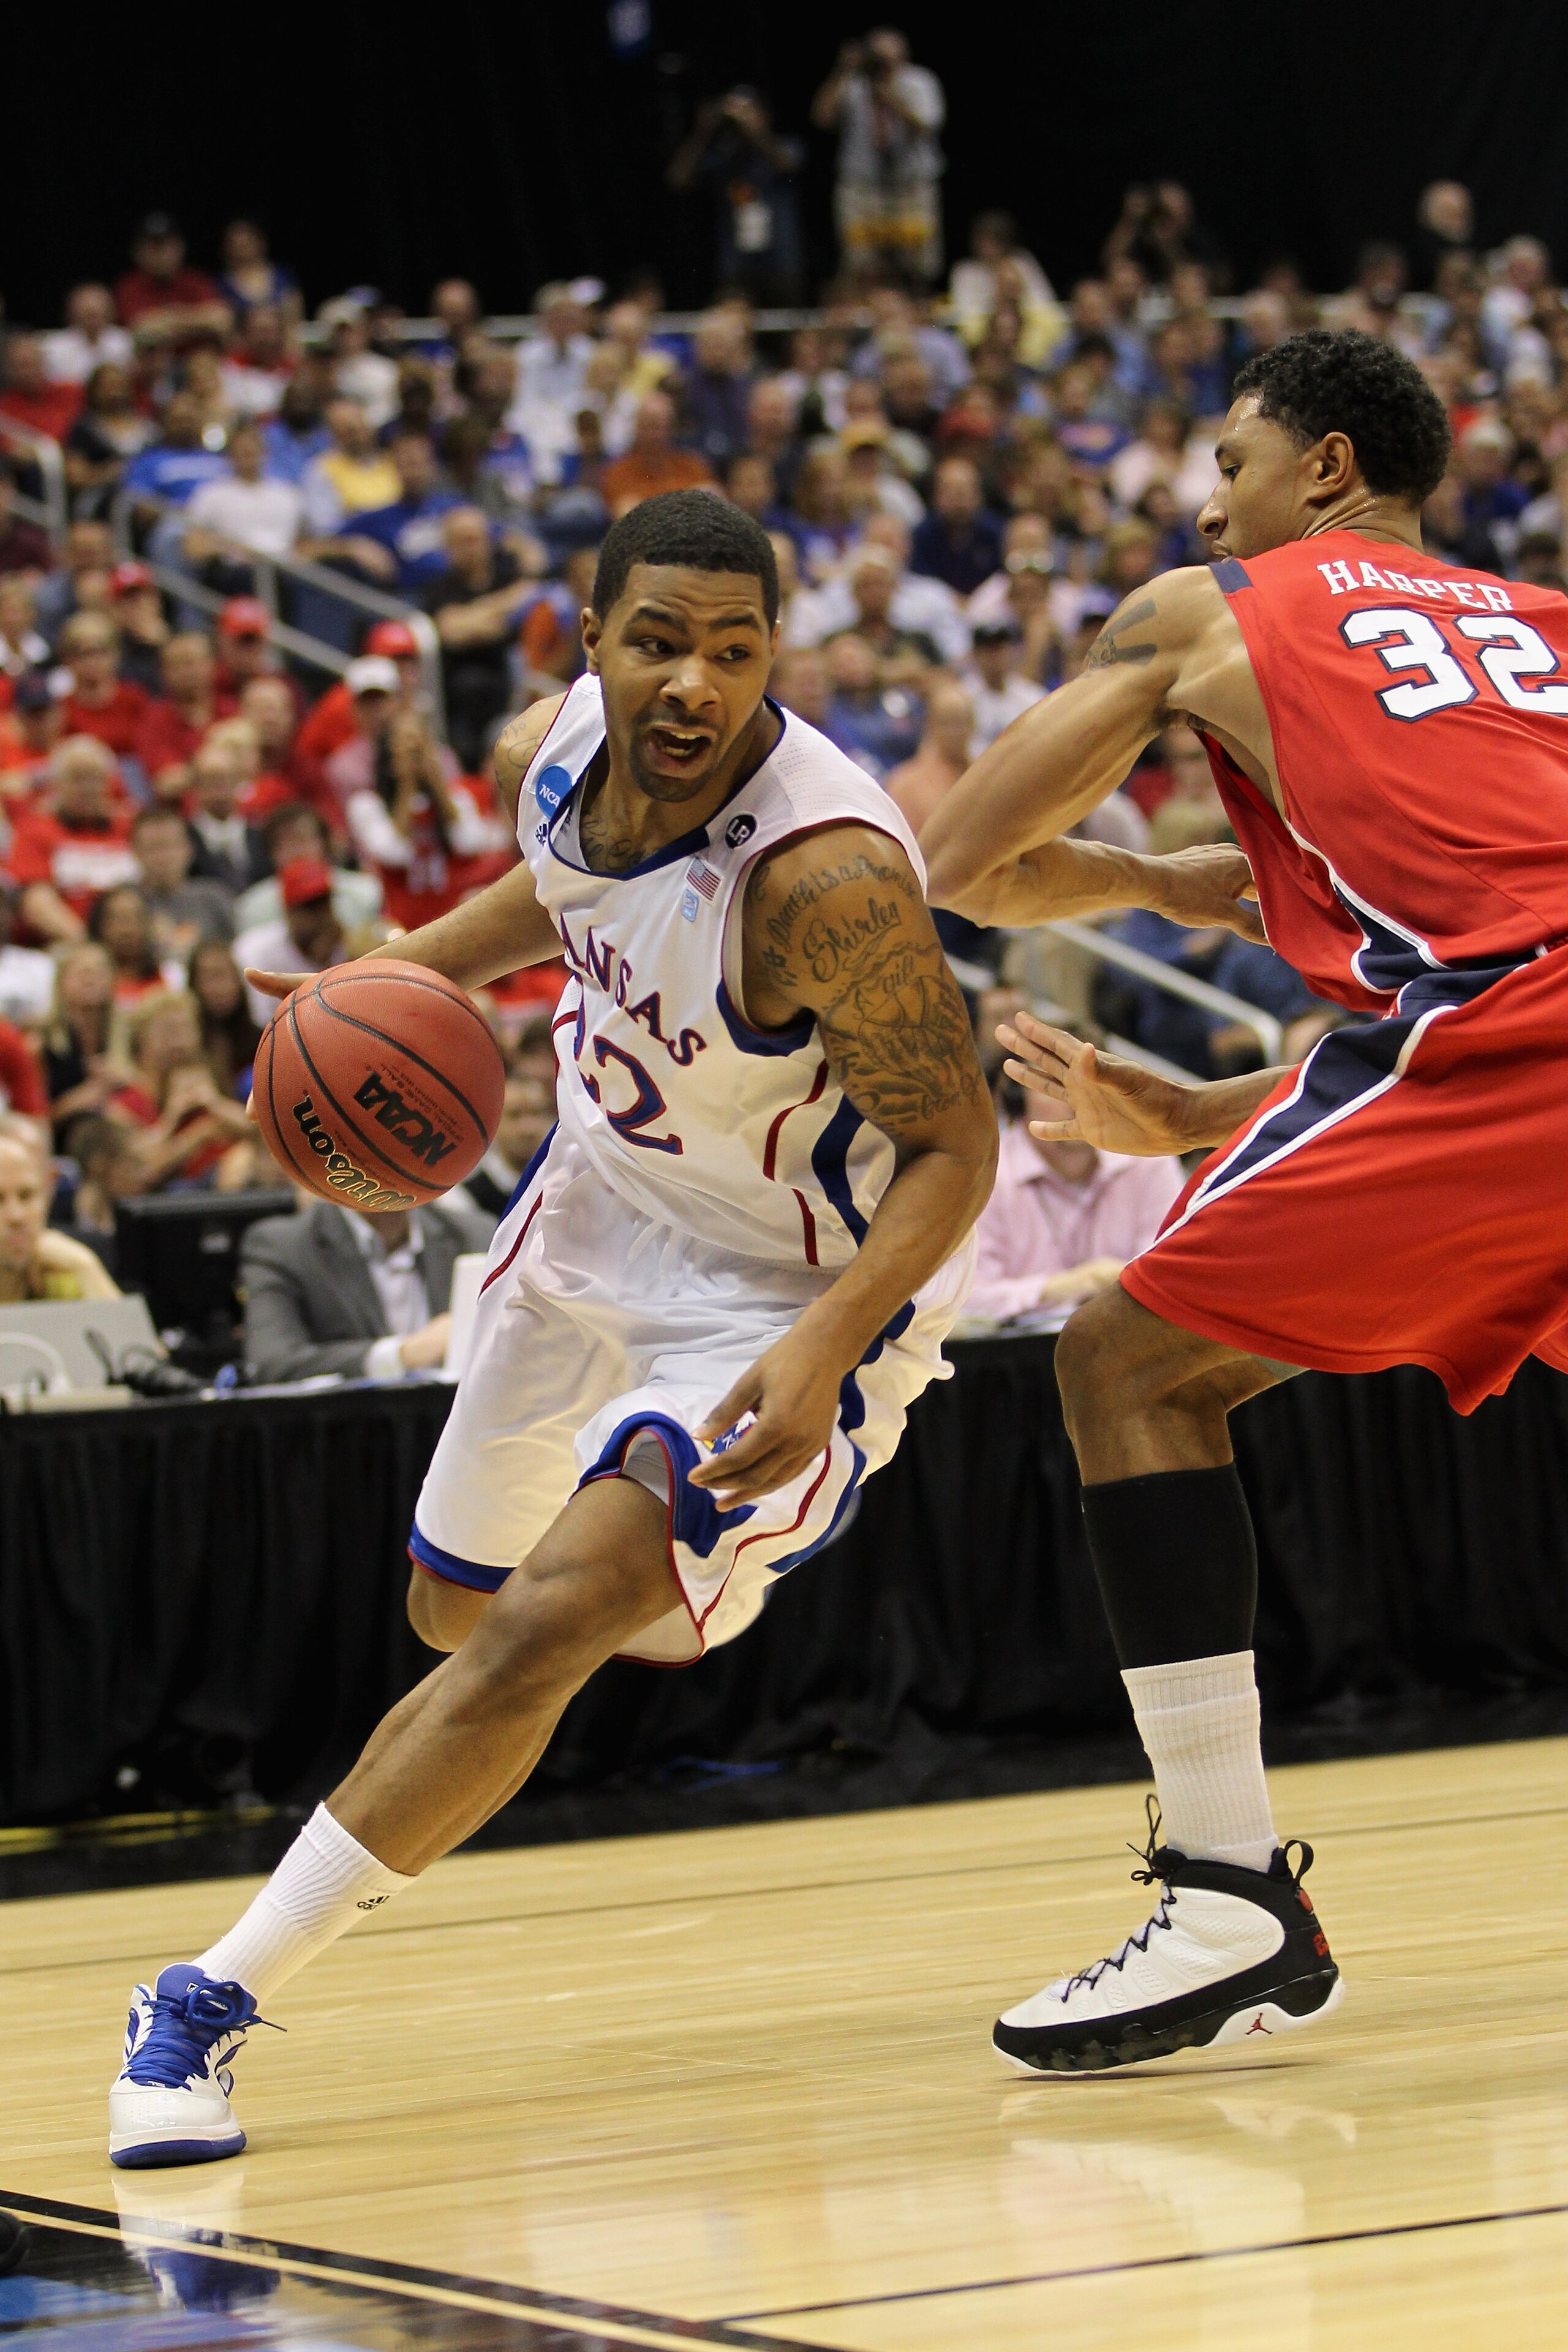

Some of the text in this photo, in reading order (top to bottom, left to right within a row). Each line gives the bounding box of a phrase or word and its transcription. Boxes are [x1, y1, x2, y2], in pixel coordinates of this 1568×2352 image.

[1316, 560, 1513, 612] HARPER
[1338, 606, 1568, 723] 32
[539, 784, 561, 809] NCA
[560, 911, 707, 1067] ANSAS
[292, 1094, 417, 1211] Wilson
[353, 1071, 456, 1166] NCAA
